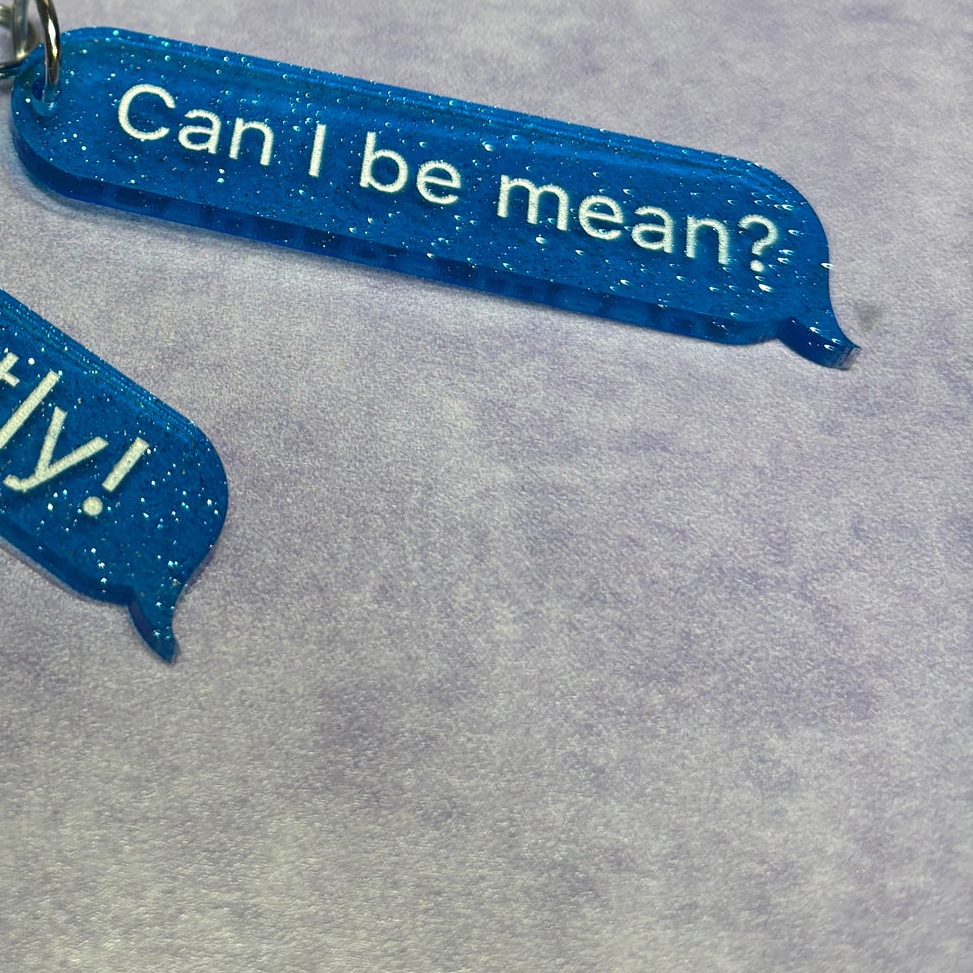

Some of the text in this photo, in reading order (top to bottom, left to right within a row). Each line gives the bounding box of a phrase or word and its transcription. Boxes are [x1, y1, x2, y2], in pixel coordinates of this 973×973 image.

[118, 84, 779, 273] Can I be mean?
